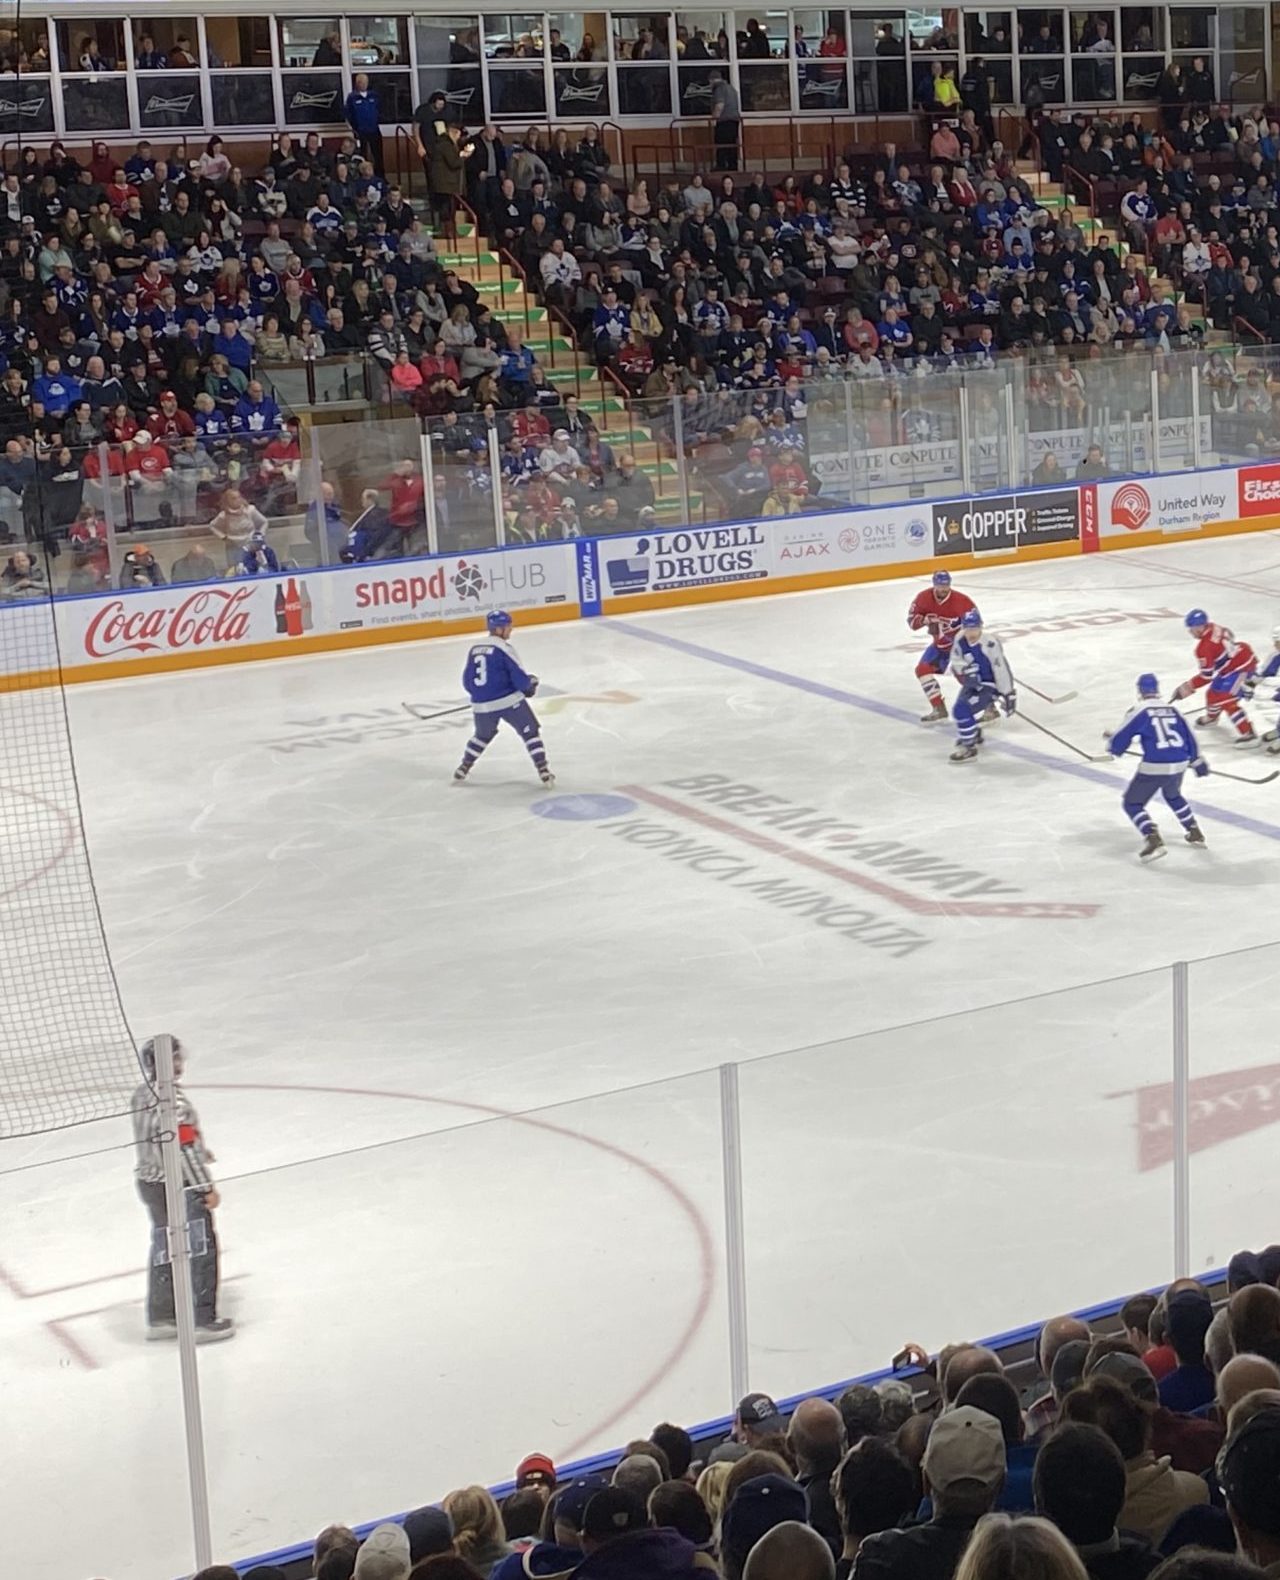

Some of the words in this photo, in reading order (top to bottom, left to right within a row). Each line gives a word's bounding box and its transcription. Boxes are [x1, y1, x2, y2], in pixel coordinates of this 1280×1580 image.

[814, 454, 883, 475] CONUTE
[1085, 489, 1093, 533] CCM
[1158, 497, 1198, 512] United
[1200, 494, 1226, 510] Way
[1158, 513, 1191, 526] Durham
[1193, 511, 1221, 524] Region
[862, 523, 897, 538] ONE
[962, 508, 1027, 540] COPPER
[654, 526, 765, 556] LOVELL
[780, 542, 830, 561] AJAX
[489, 562, 546, 593] HUB
[656, 549, 754, 580] DRUGS
[355, 566, 446, 610] snapd
[84, 585, 259, 659] Coca-Cola
[371, 614, 390, 626] Find
[474, 654, 487, 687] 3
[1151, 716, 1184, 750] 15
[659, 774, 863, 839] BREAK
[824, 840, 1023, 899] AWAY
[596, 818, 756, 881] KONICA
[731, 877, 934, 959] MINOLTA
